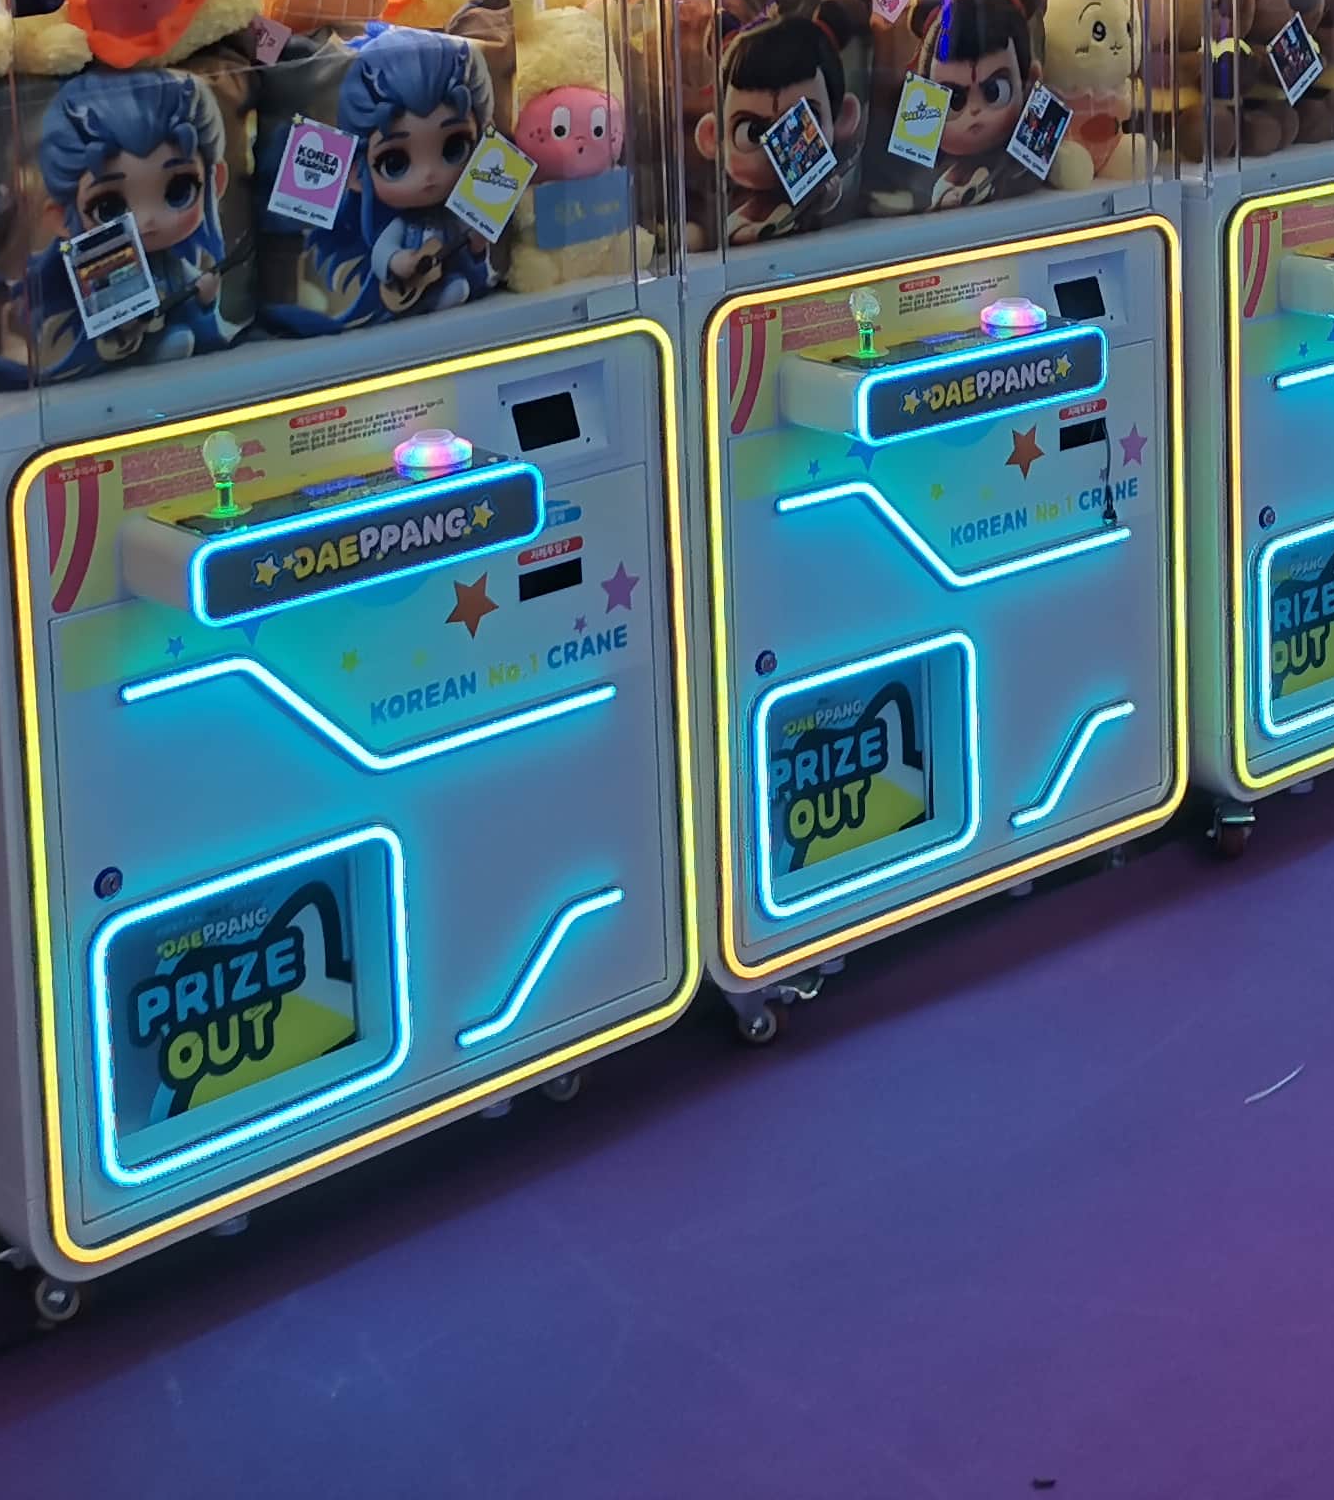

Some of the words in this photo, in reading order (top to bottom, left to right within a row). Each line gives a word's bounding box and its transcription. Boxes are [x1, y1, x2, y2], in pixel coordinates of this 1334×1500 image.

[296, 144, 340, 168] KOREA
[929, 359, 1053, 412] DAEPPANG
[292, 506, 467, 582] DAEPPANG
[950, 508, 1028, 548] KOREAN
[370, 671, 477, 726] KOREAN
[487, 652, 540, 688] No.1
[546, 623, 629, 669] CRANE
[1272, 624, 1326, 674] OUT
[771, 727, 884, 791] PRIZE
[789, 779, 866, 838] OUT
[162, 907, 269, 959] DAEPPANG
[137, 937, 298, 1039] PRIZE
[166, 1002, 274, 1080] OUT
